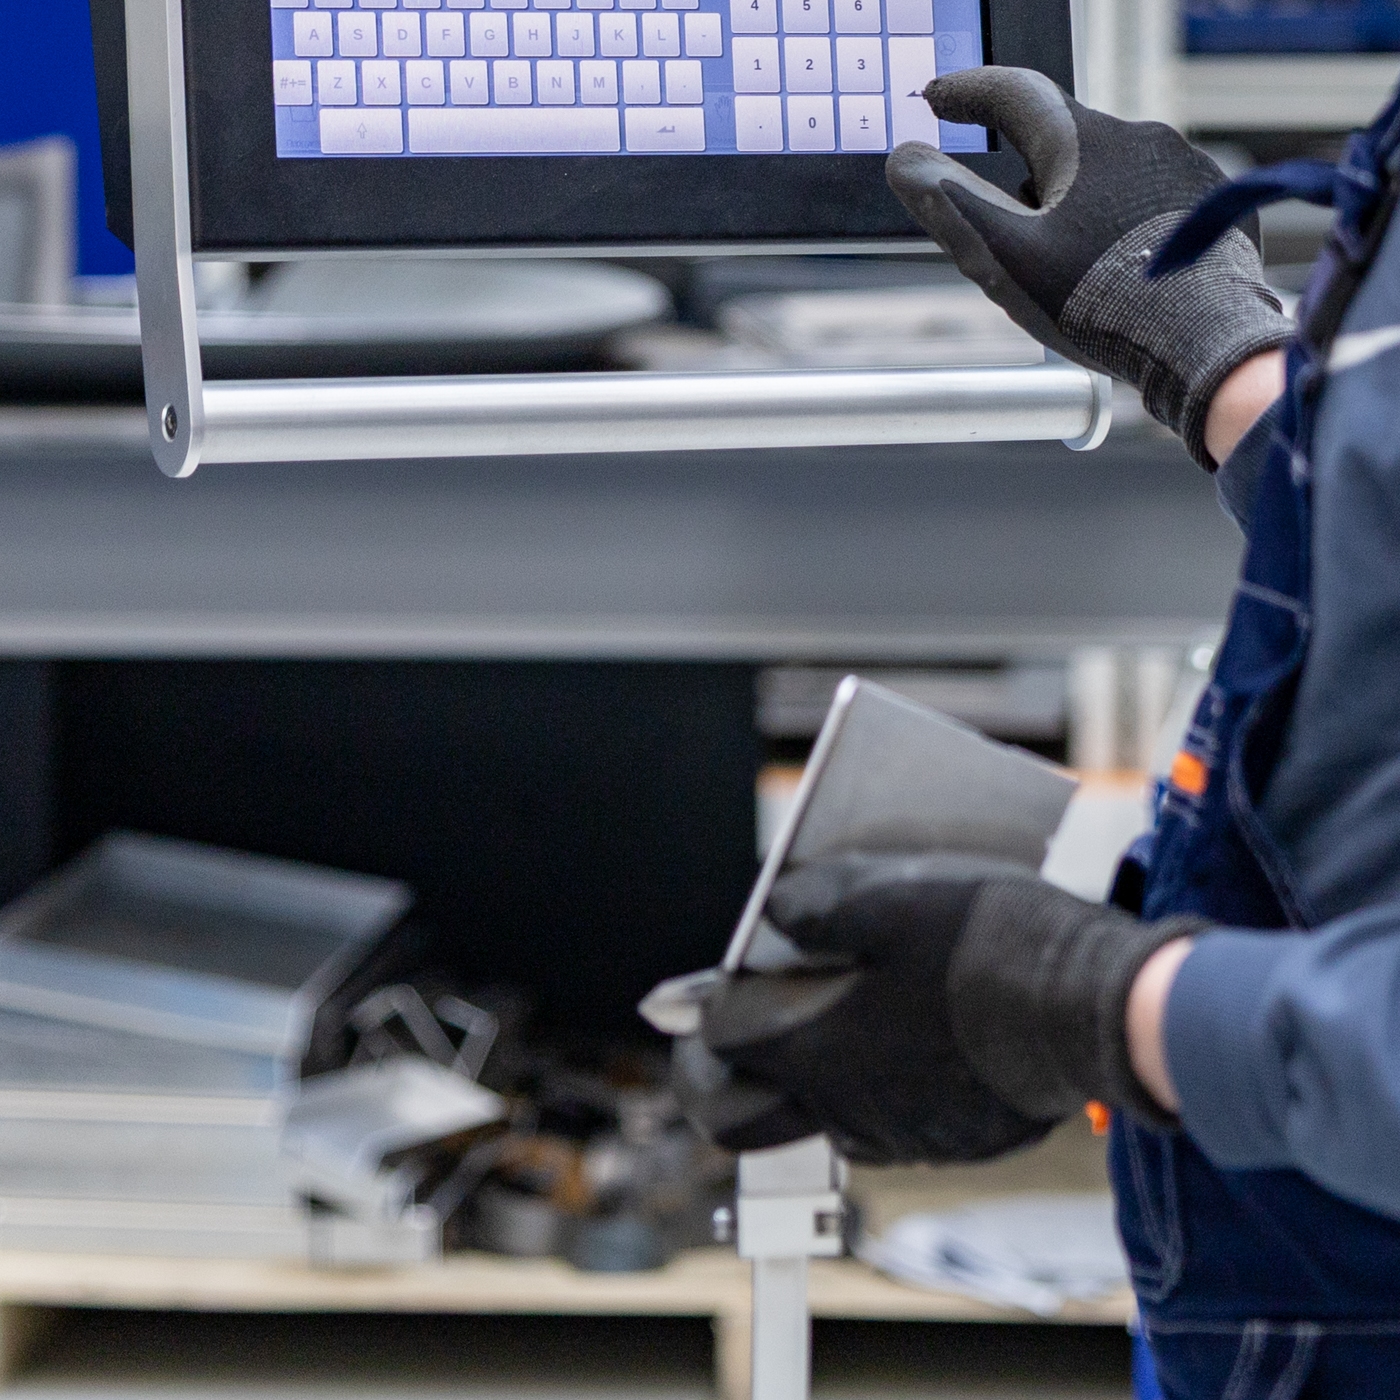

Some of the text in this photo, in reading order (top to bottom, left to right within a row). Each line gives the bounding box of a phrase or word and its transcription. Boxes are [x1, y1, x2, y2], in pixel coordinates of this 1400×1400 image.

[751, 0, 862, 11] 4 5 6
[309, 28, 665, 41] A S D F G H J K L
[754, 59, 865, 70] 1 2 3
[333, 77, 342, 89] Z
[377, 77, 387, 89] X
[421, 77, 431, 89] C
[464, 77, 474, 89] V
[508, 77, 518, 89] B
[551, 77, 561, 89] N
[593, 77, 605, 89] M
[809, 117, 816, 129] 0
